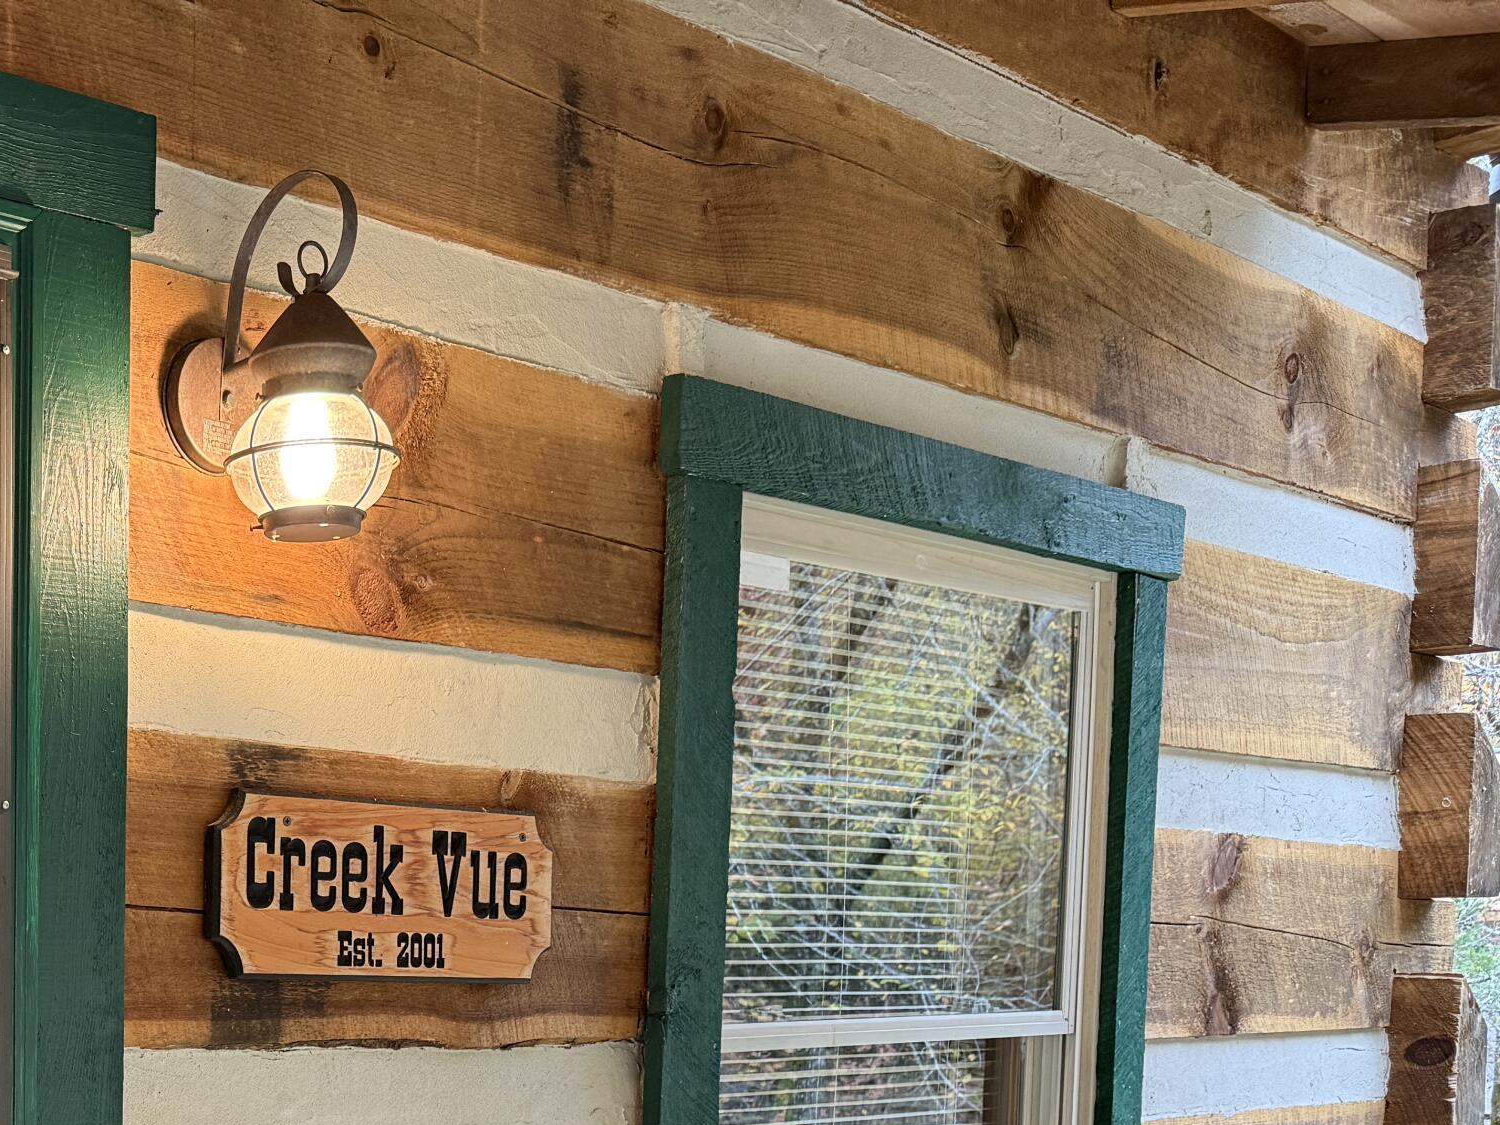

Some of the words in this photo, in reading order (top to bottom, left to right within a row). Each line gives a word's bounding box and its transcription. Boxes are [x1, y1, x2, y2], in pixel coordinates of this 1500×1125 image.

[246, 816, 404, 916] Creek
[432, 830, 528, 920] Vue
[337, 930, 383, 968] Est.
[397, 932, 445, 969] 2001
